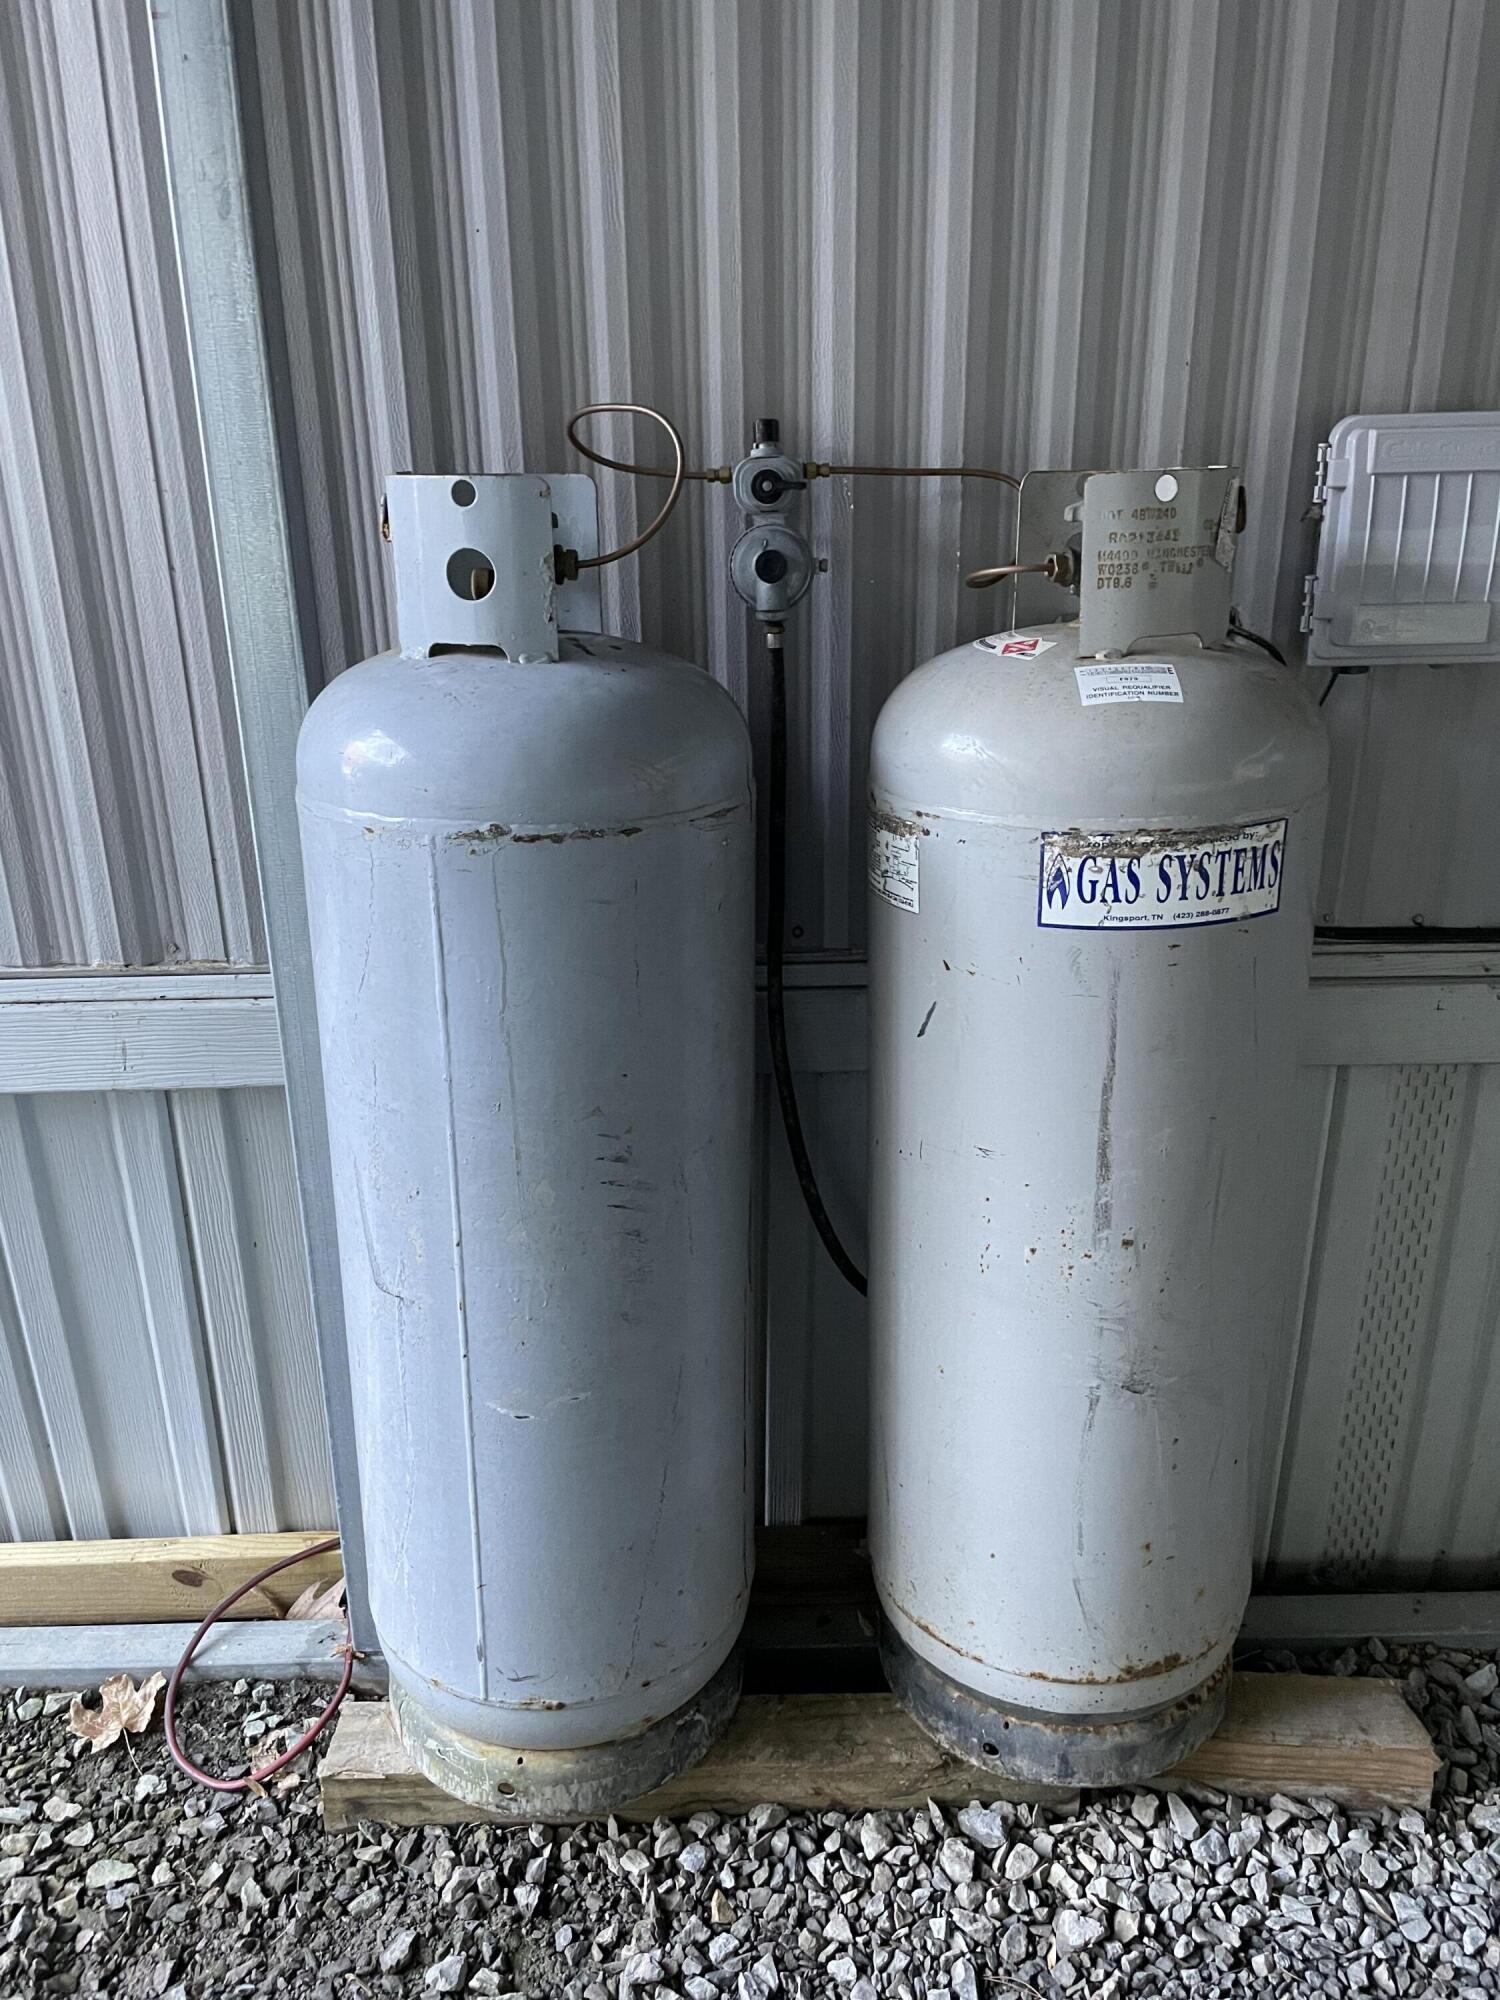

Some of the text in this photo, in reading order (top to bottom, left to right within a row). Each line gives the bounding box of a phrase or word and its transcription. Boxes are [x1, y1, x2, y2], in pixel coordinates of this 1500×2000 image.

[1086, 690, 1145, 699] IDENTIFICATION
[1081, 839, 1136, 850] roperty
[1077, 839, 1282, 904] GAS SYSTEMS
[1103, 914, 1150, 923] Kingsport,
[1151, 913, 1164, 921] TN
[1173, 911, 1194, 920] (423)
